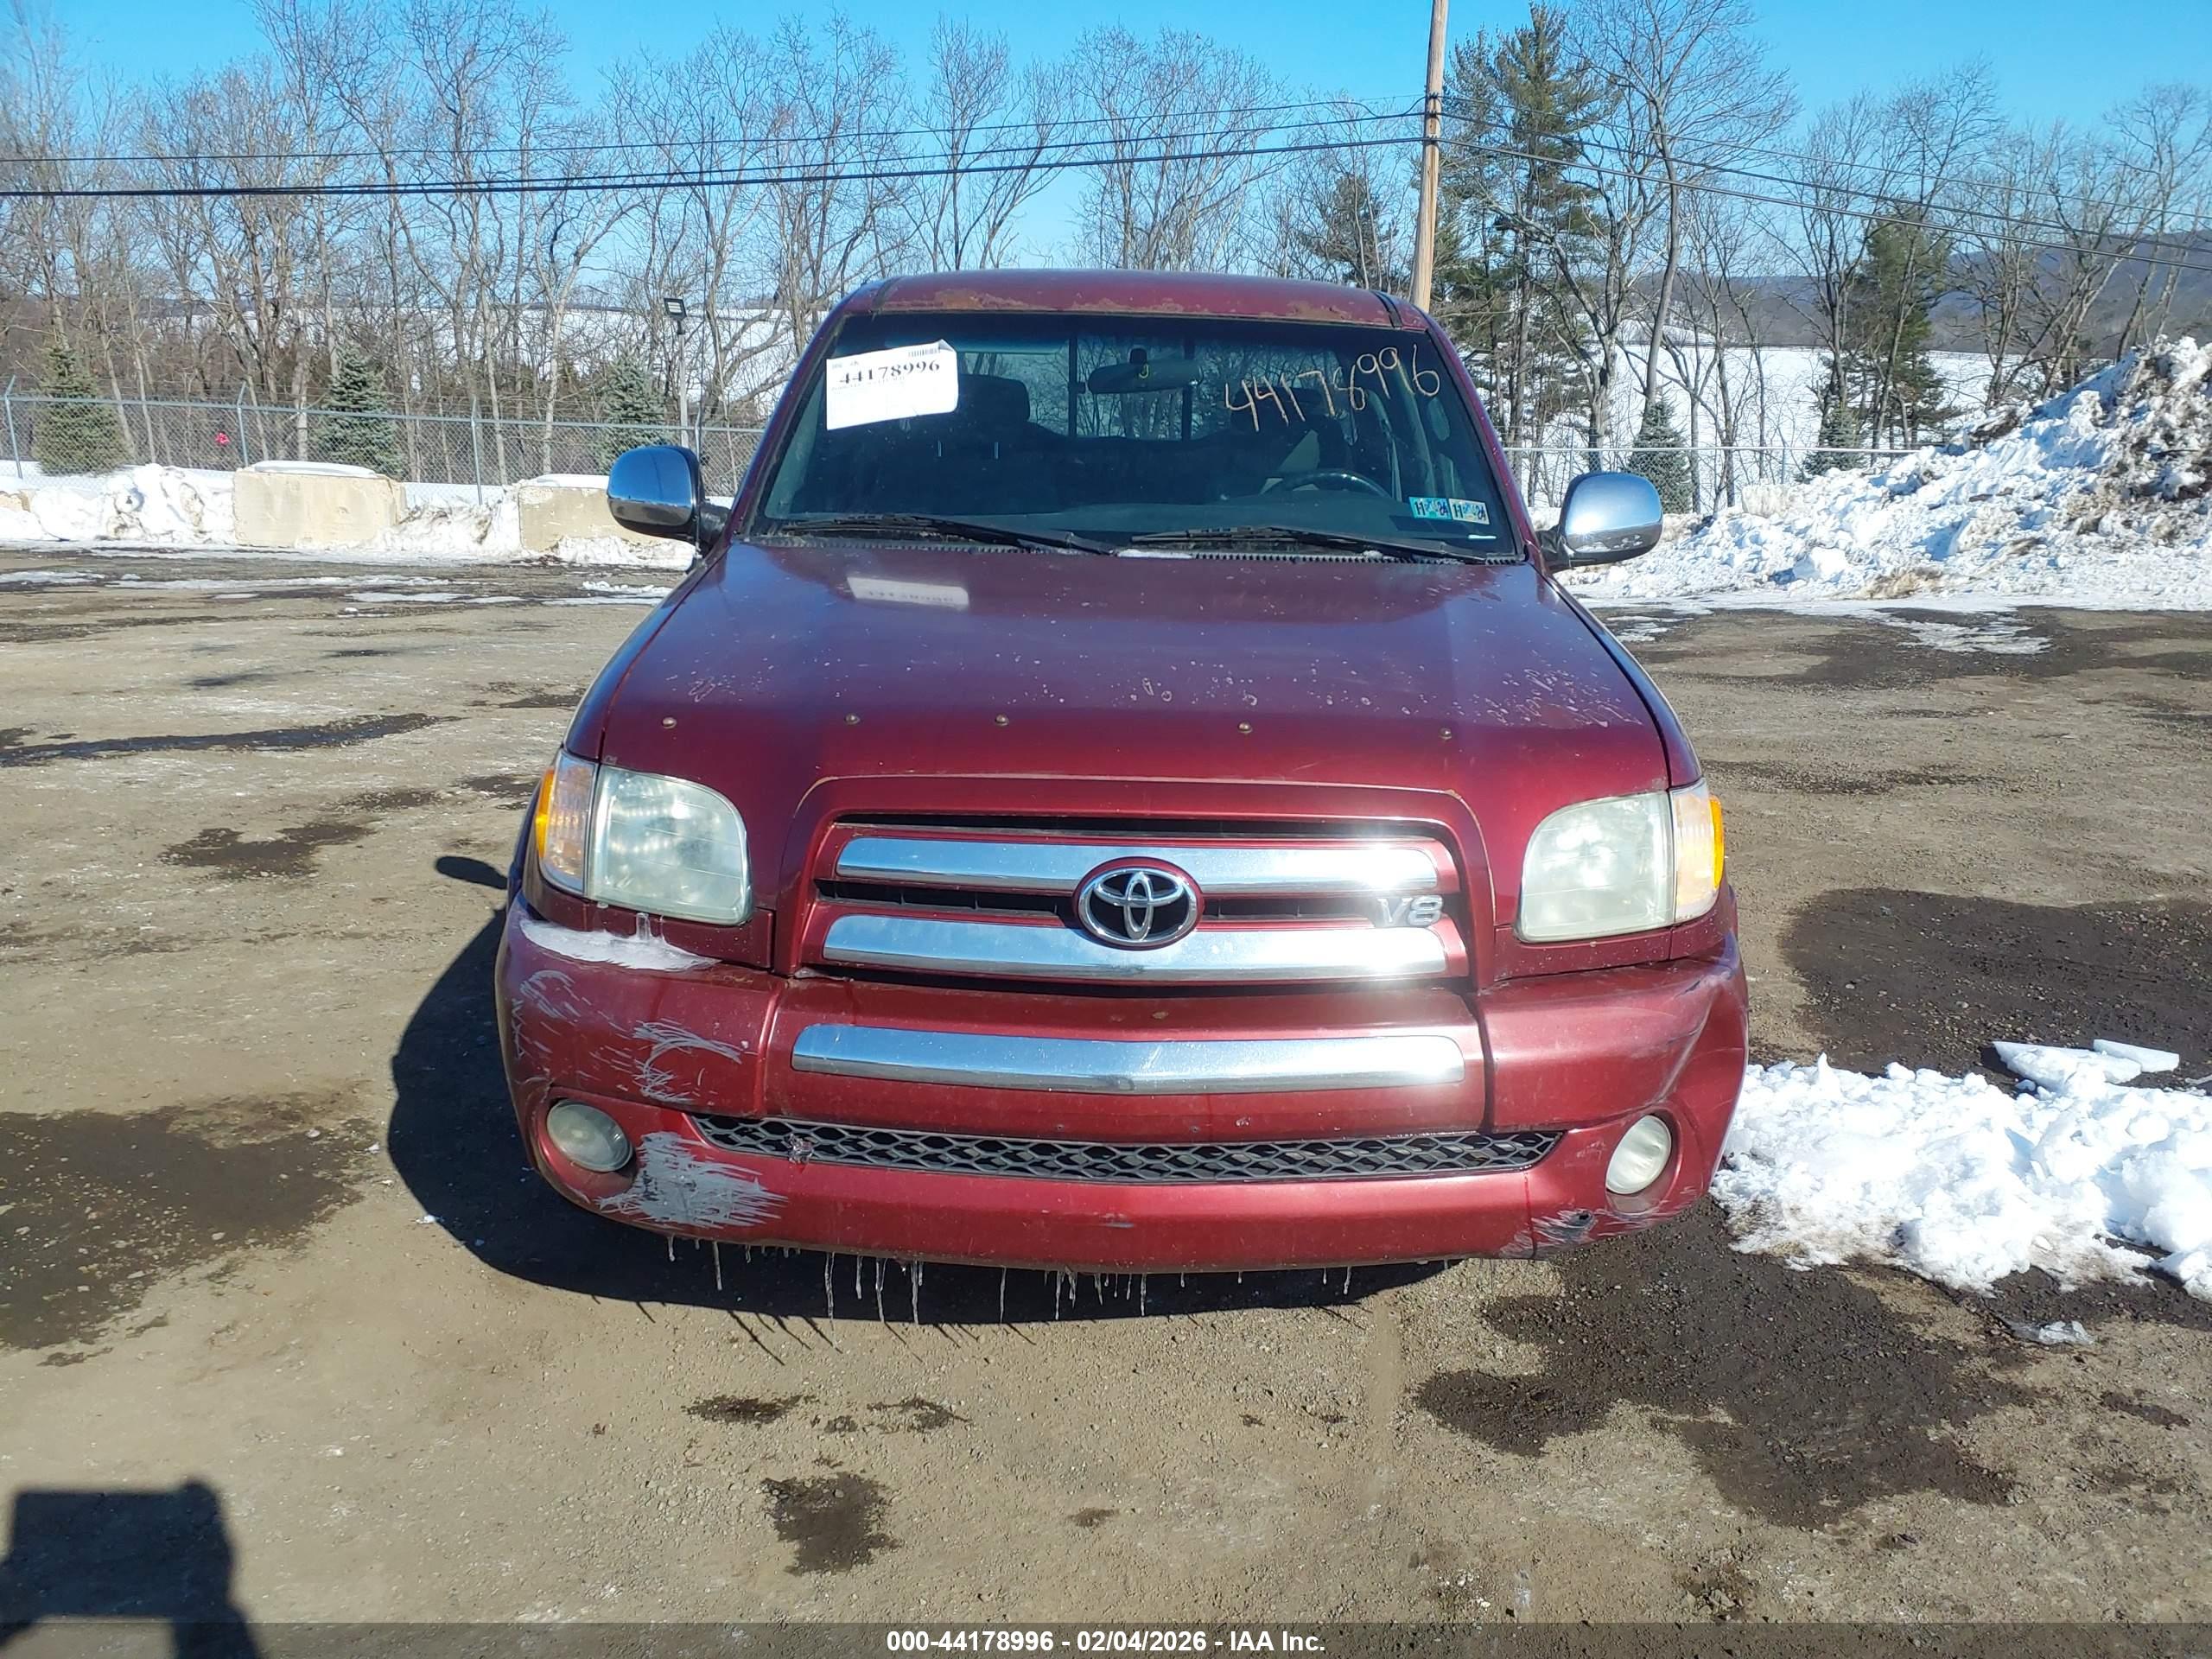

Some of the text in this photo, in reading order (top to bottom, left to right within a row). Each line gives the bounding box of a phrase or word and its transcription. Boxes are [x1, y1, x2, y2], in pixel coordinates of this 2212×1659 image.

[839, 359, 940, 385] 44178996
[1225, 343, 1440, 432] 44178996
[1376, 894, 1443, 927] V8
